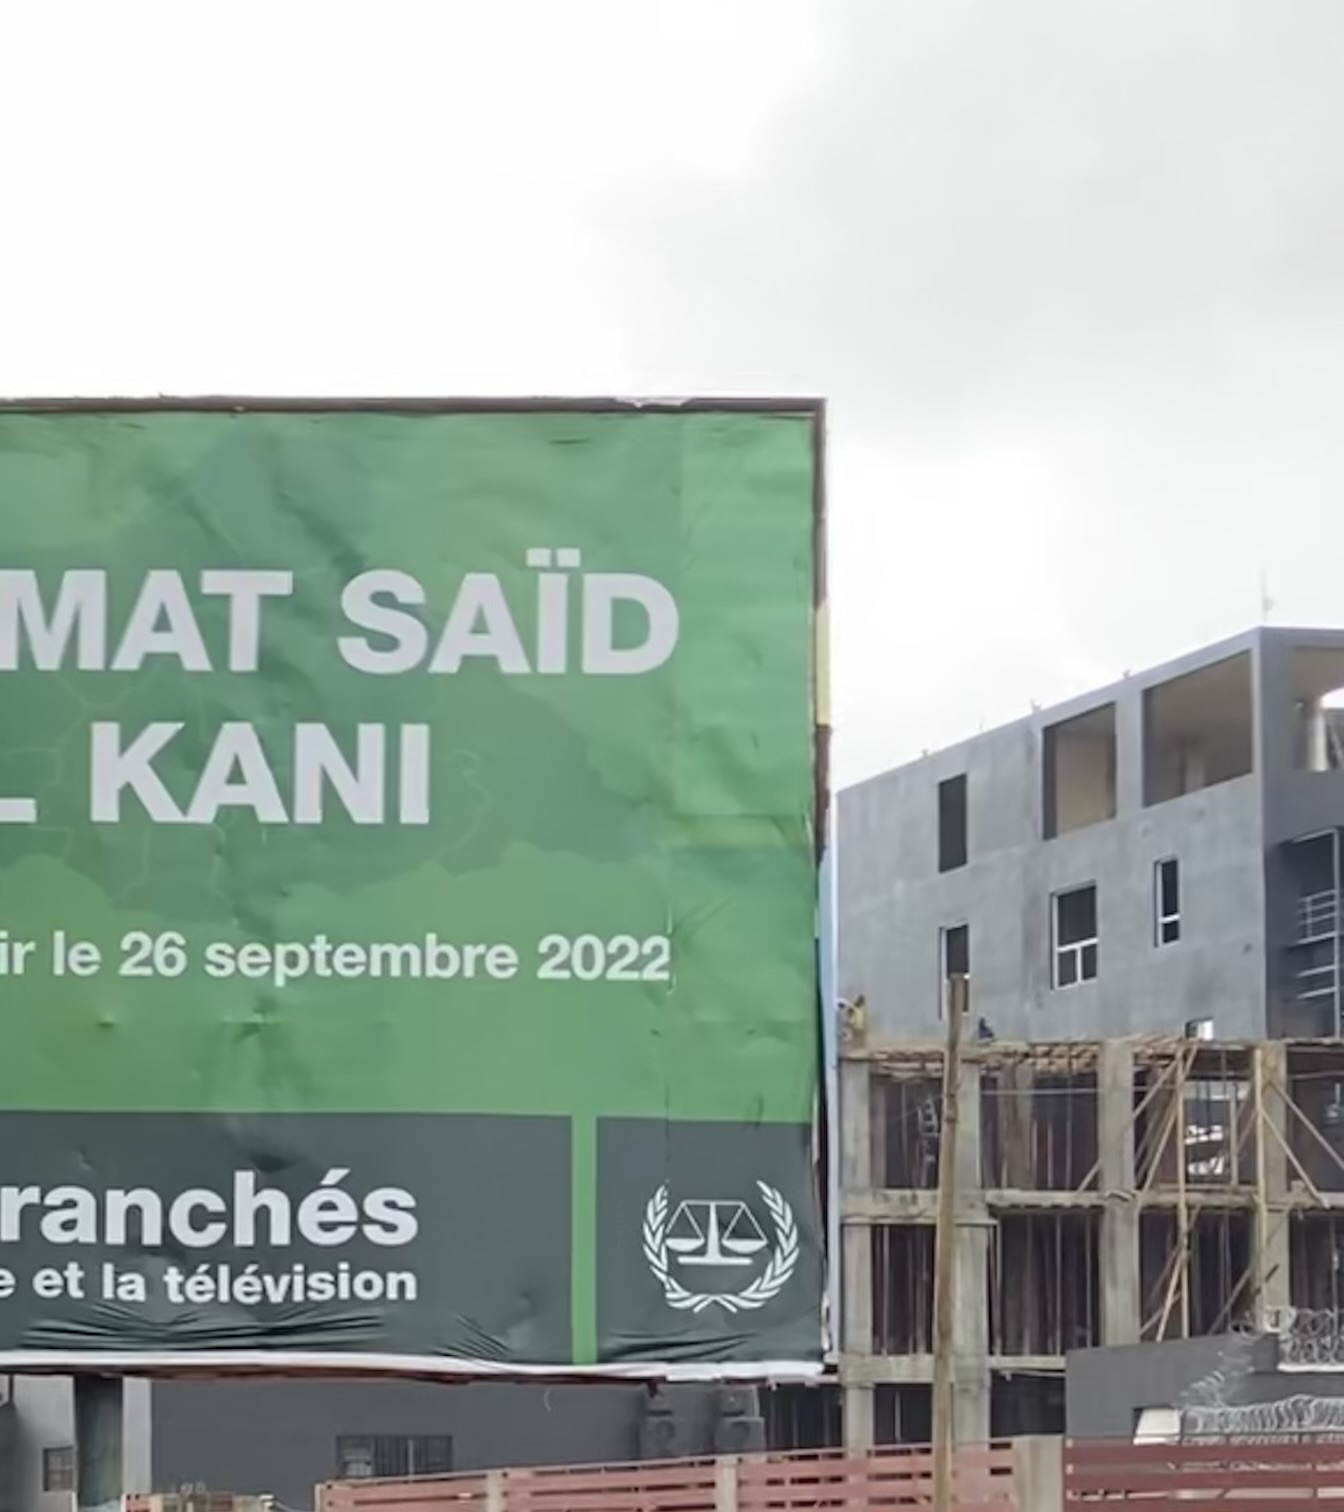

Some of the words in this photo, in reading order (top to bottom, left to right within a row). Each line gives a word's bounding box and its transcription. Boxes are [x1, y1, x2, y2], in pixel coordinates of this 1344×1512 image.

[337, 546, 682, 677] SAÏD
[89, 720, 431, 826] KANI
[52, 929, 102, 977] le
[118, 931, 188, 978] 26
[204, 931, 520, 990] septembre
[535, 932, 672, 983] 2022
[32, 1261, 86, 1301] et
[102, 1262, 147, 1304] la
[161, 1260, 419, 1306] télévision
